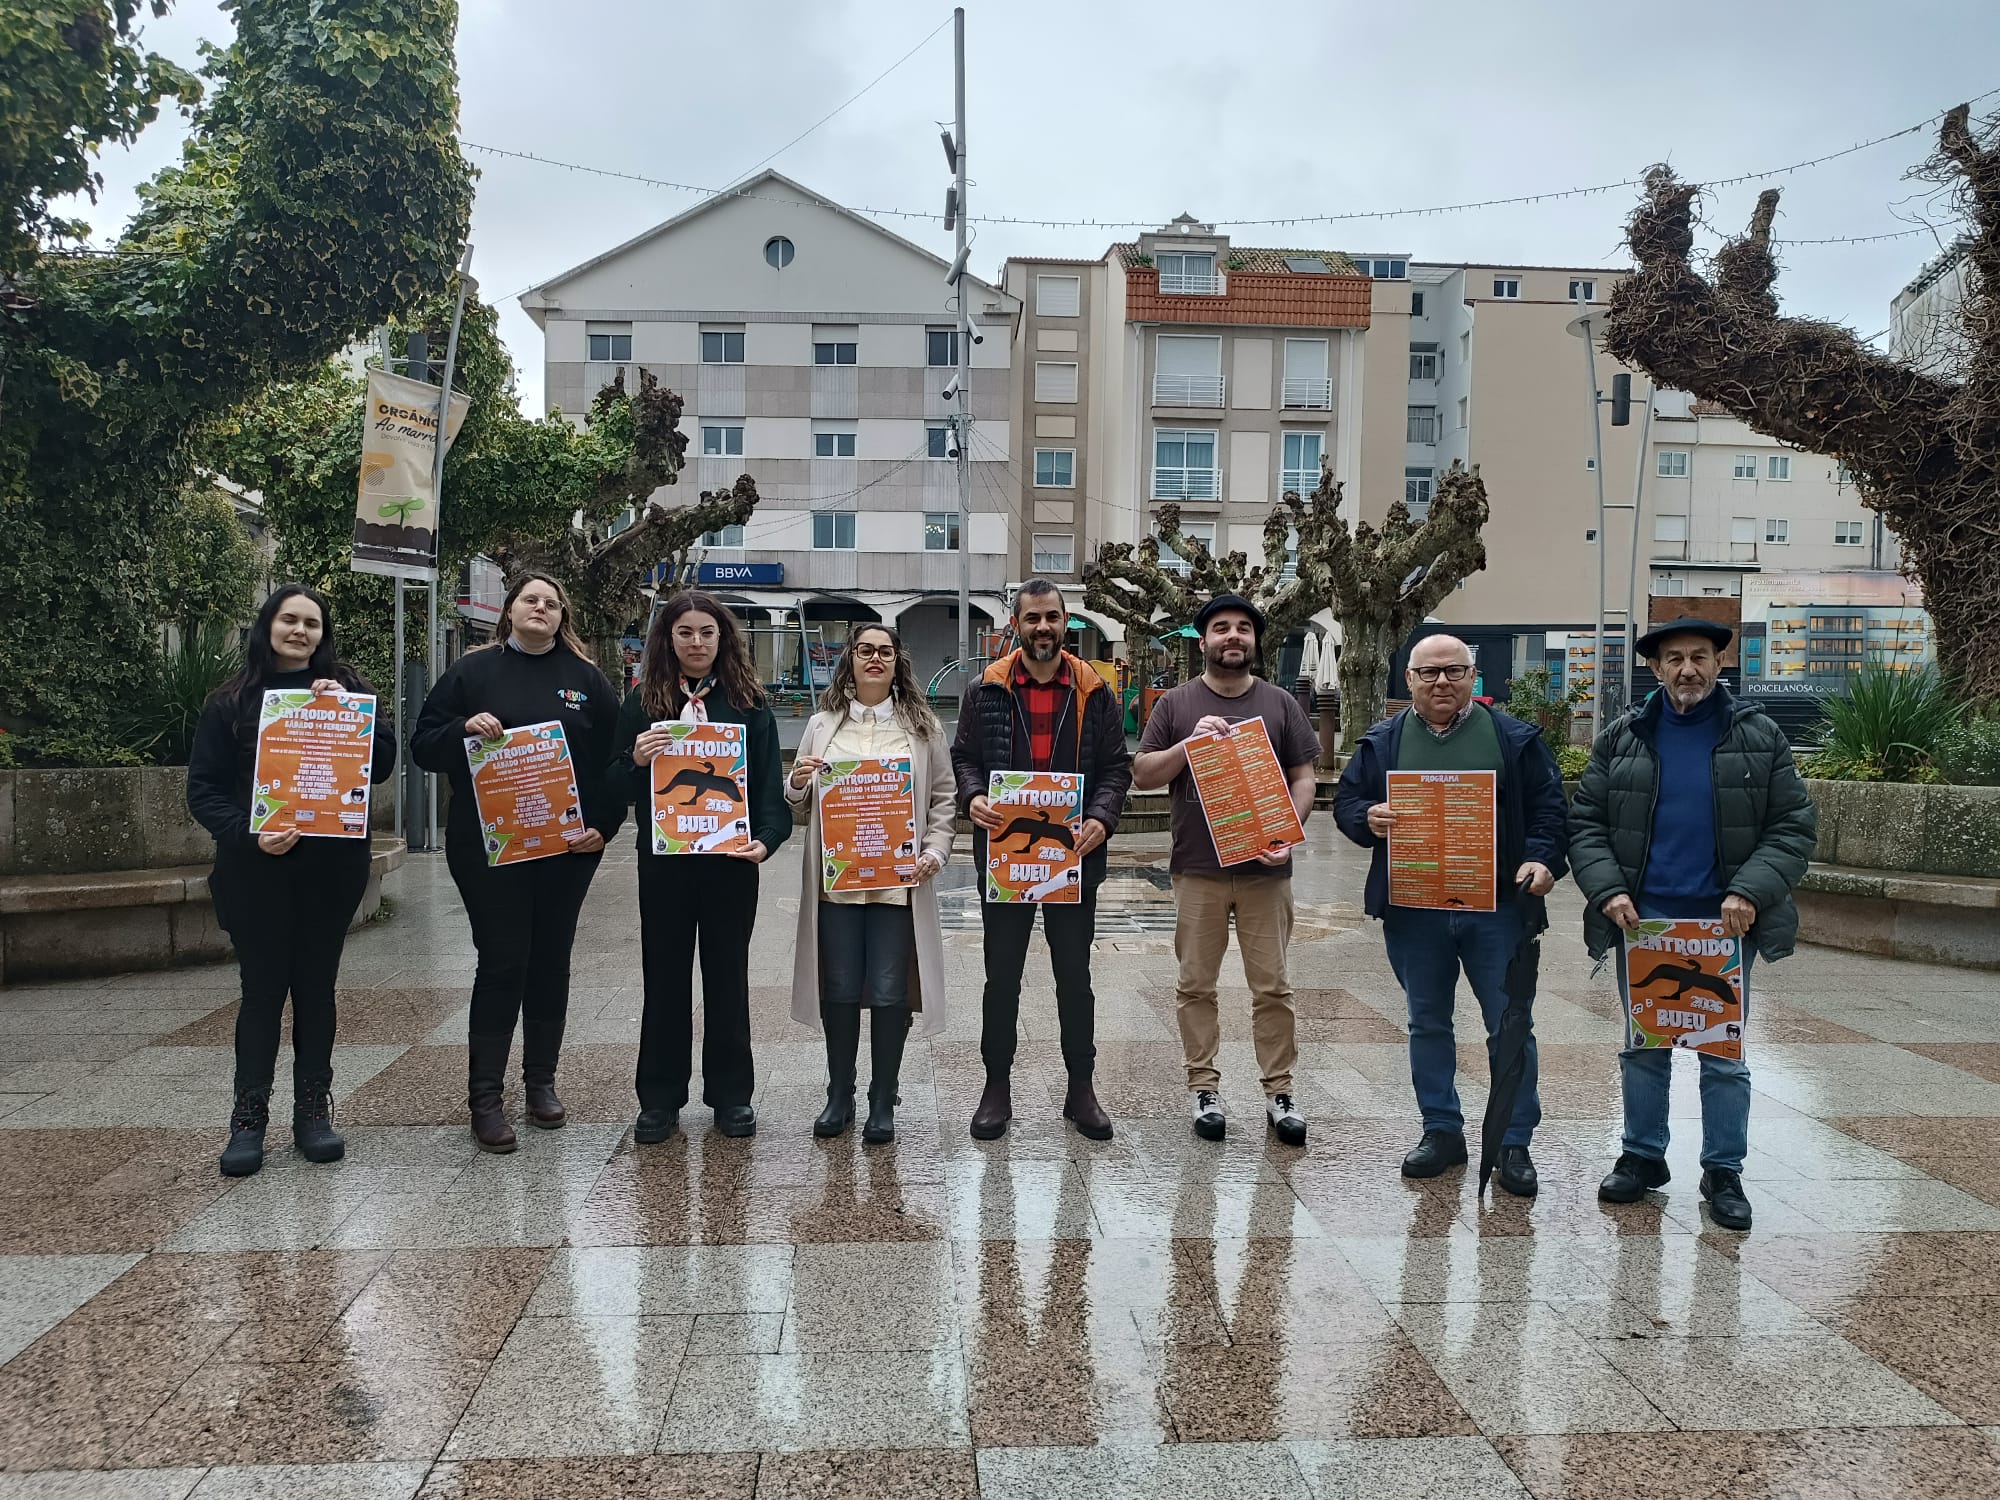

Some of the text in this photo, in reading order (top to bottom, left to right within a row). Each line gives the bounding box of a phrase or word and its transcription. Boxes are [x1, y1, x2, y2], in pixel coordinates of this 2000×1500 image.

[375, 417, 395, 431] Ao
[715, 567, 753, 578] BBVA
[1748, 684, 1814, 693] PORCELANOSA
[281, 707, 365, 724] ENTROIDO CELA
[536, 739, 560, 752] CELA
[664, 740, 742, 758] ENTROIDO
[833, 772, 905, 786] ENTROIDO CELA
[1420, 774, 1460, 783] PROGRAMA
[1000, 788, 1078, 808] ENTROIDO
[677, 815, 720, 833] BUEU
[1009, 863, 1051, 882] BUEU
[1639, 933, 1735, 957] ENTROIDO
[1656, 1008, 1707, 1032] BUEU
